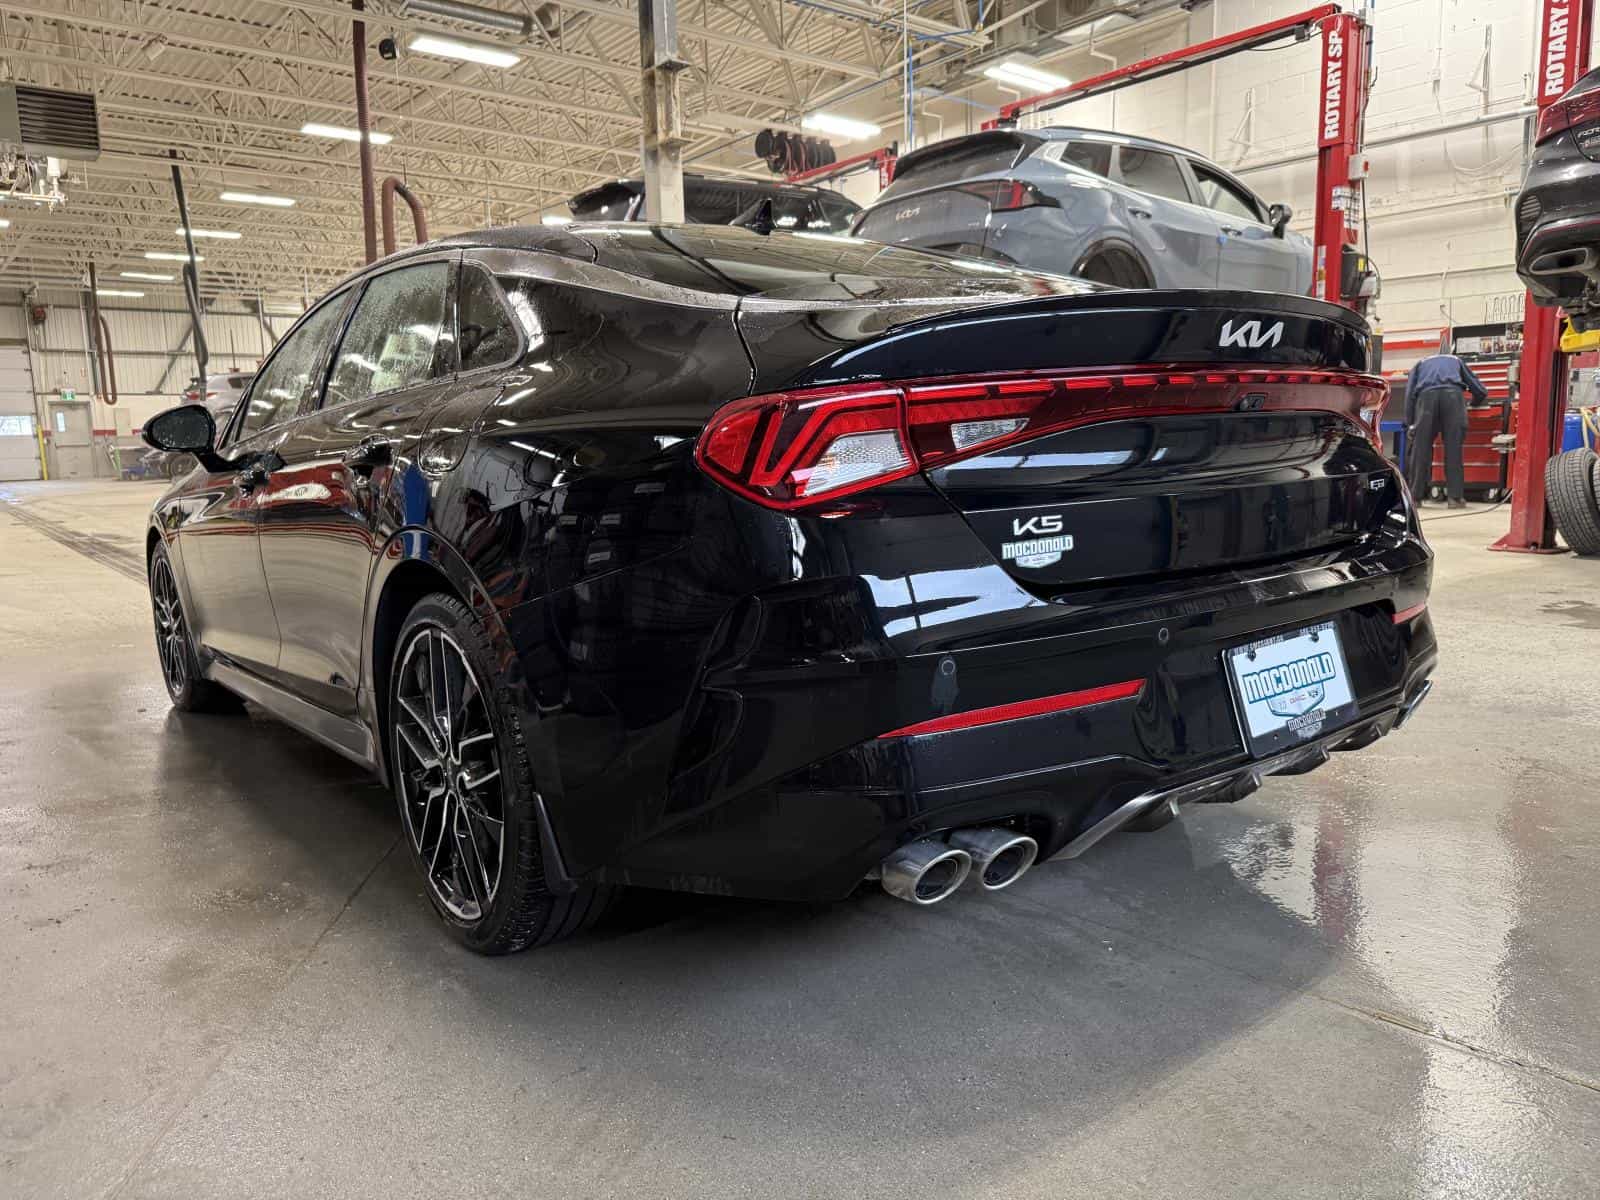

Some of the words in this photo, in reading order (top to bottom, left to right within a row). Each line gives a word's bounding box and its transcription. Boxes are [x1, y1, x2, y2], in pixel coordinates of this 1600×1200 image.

[1328, 30, 1343, 58] SP
[1545, 6, 1569, 97] ROTARY
[1324, 59, 1342, 140] ROTARY
[1219, 320, 1284, 347] KIA
[1013, 514, 1063, 536] K5
[1002, 535, 1073, 560] MACDONALD
[1242, 652, 1336, 704] MACDONALD
